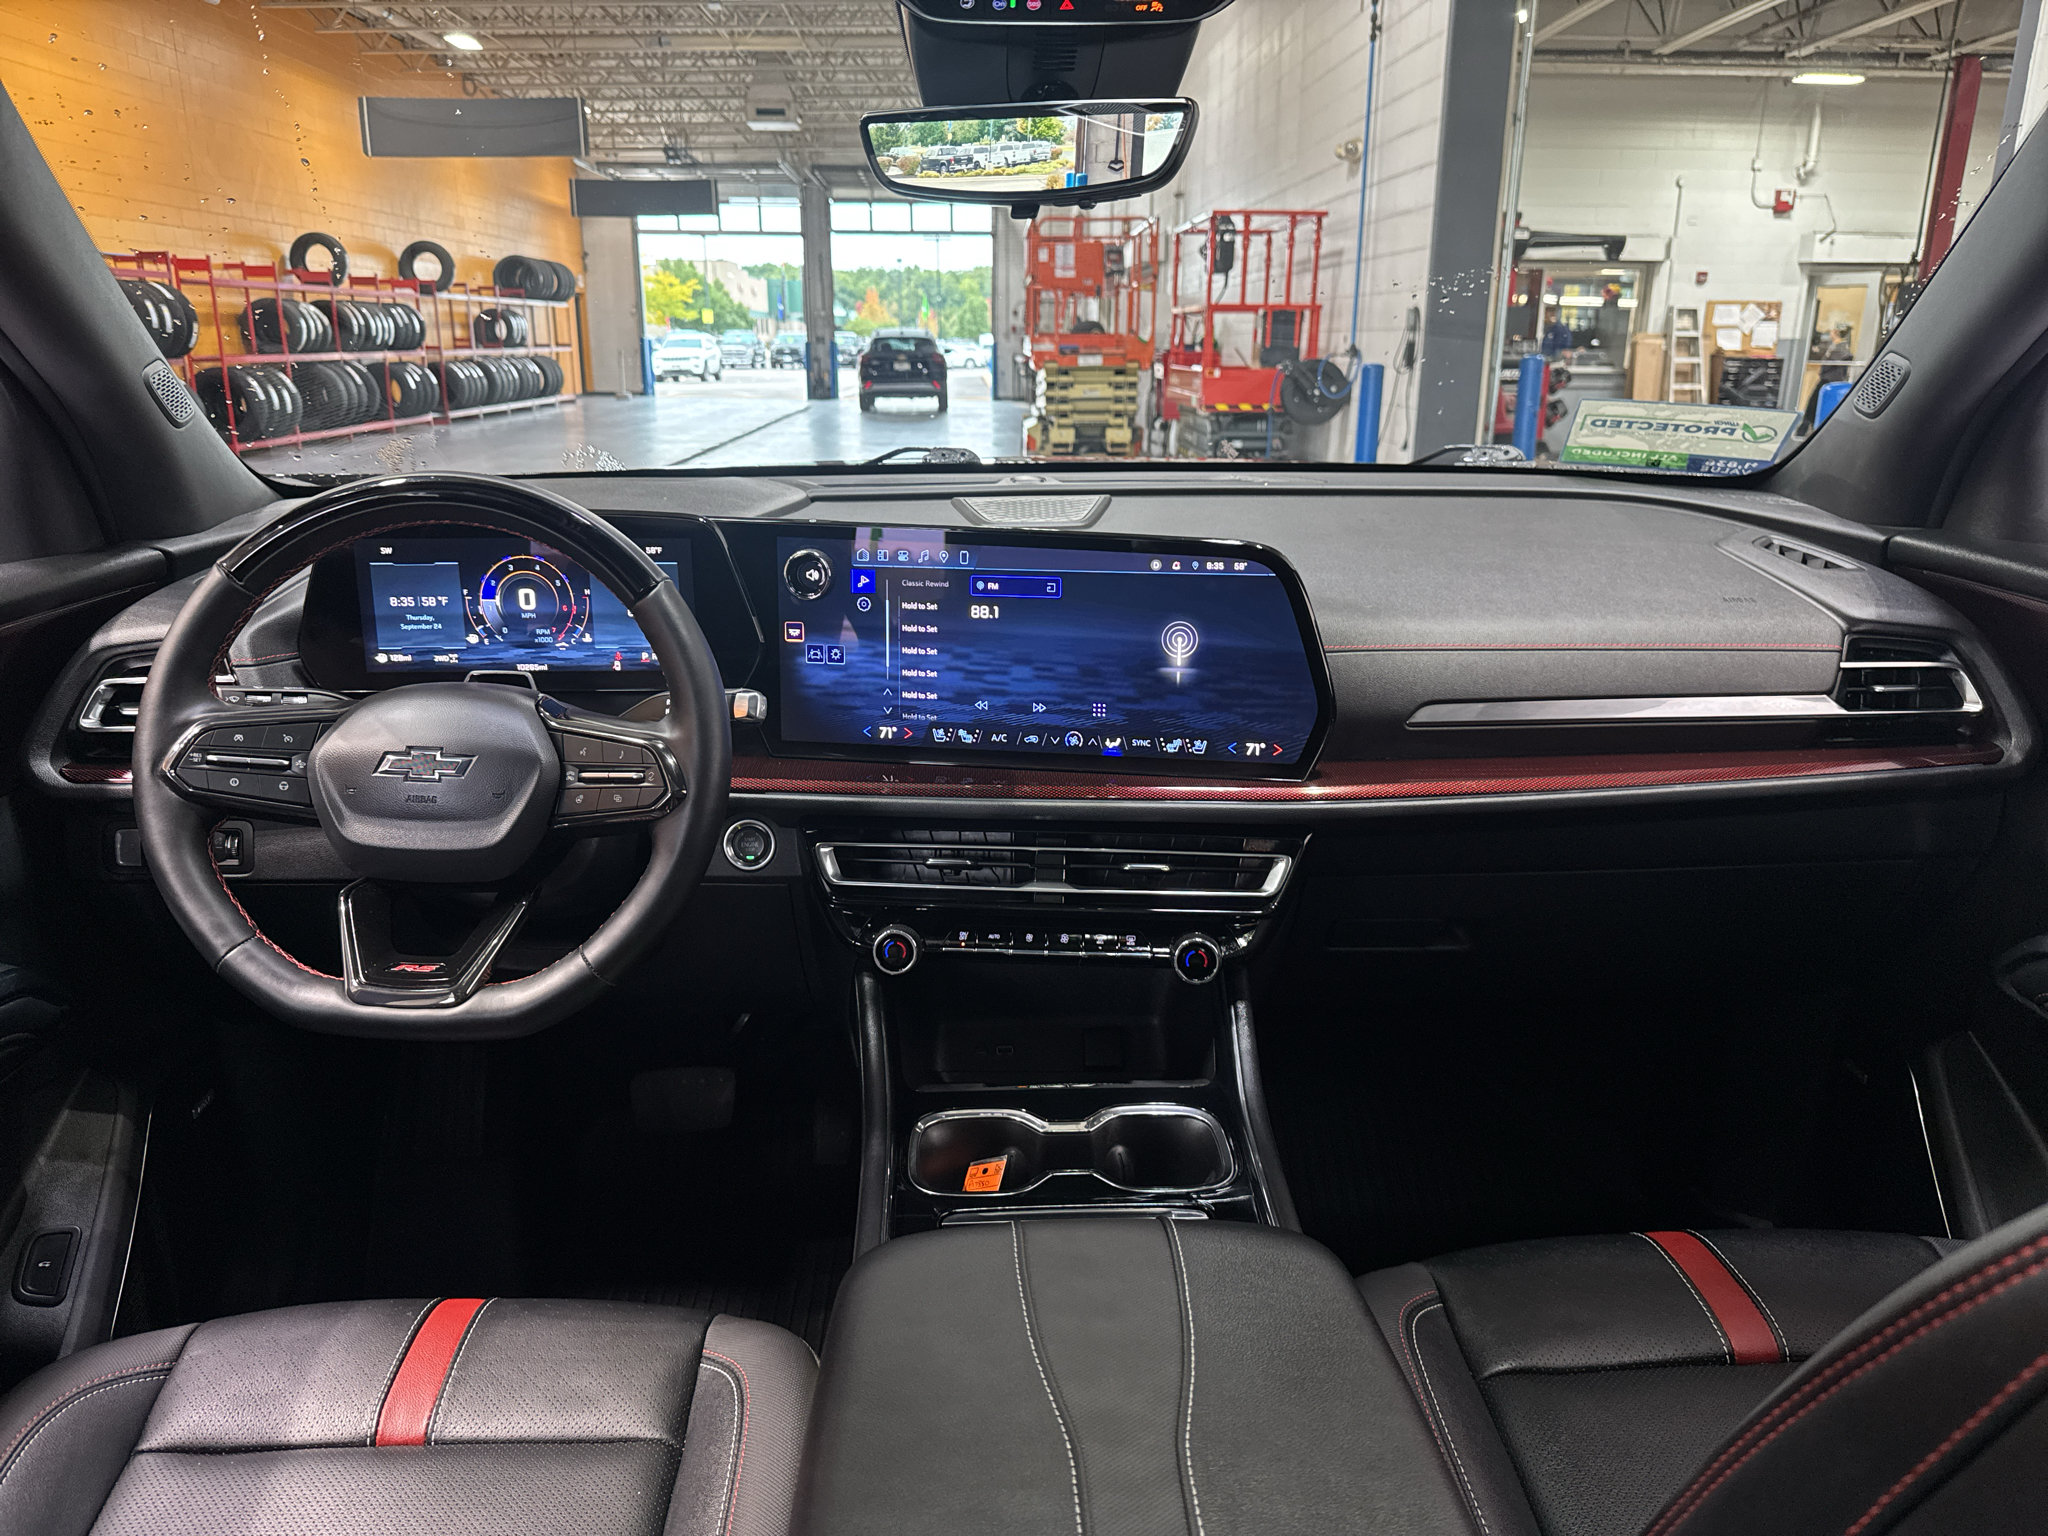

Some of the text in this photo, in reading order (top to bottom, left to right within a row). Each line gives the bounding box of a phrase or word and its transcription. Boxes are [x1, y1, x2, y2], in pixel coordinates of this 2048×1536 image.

[1135, 4, 1148, 12] OFF
[379, 546, 393, 555] SW
[1206, 561, 1224, 570] 8:35
[901, 579, 950, 588] Classic Rewind
[987, 582, 999, 590] FM
[389, 596, 415, 607] 8:35
[421, 596, 437, 607] 58
[518, 588, 537, 611] 0
[901, 602, 938, 611] Hold to Set
[970, 604, 999, 619] 88.1
[405, 614, 435, 622] Thursday,
[400, 623, 433, 631] September
[901, 624, 938, 633] Hold to Set
[641, 652, 649, 660] P
[901, 647, 938, 656] Hold to Set
[901, 669, 938, 678] Hold to Set
[901, 691, 938, 700] Hold to Set
[878, 726, 898, 739] 71°
[990, 733, 1008, 743] A/C
[1131, 738, 1151, 747] SYNC
[1245, 742, 1266, 756] 71°
[405, 794, 438, 804] AIRBAG
[391, 963, 441, 973] RS
